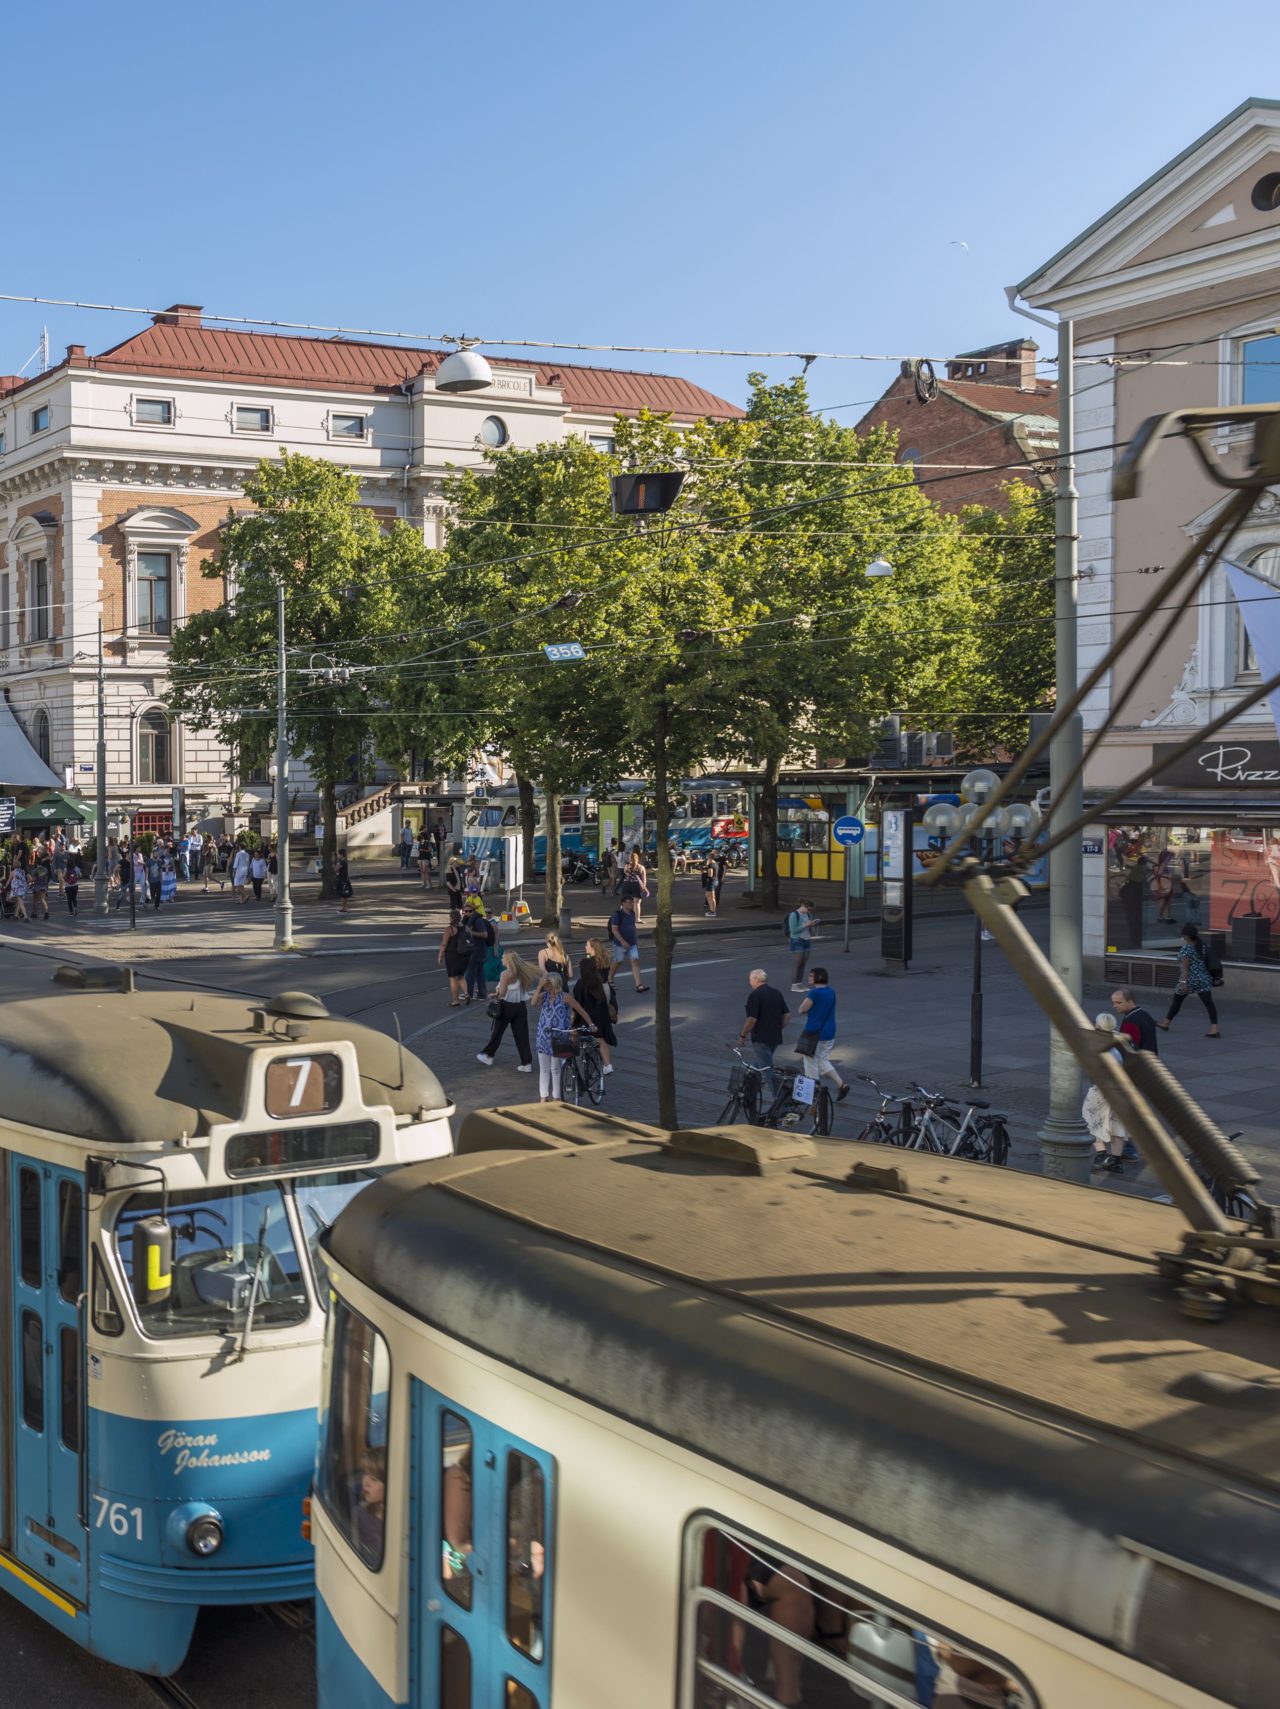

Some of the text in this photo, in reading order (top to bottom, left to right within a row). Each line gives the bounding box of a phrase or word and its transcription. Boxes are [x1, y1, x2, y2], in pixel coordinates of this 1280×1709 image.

[1221, 848, 1268, 867] SAL
[287, 1056, 312, 1107] 7
[157, 1429, 218, 1455] Göran
[174, 1448, 271, 1476] Johansson
[92, 1494, 143, 1541] 761
